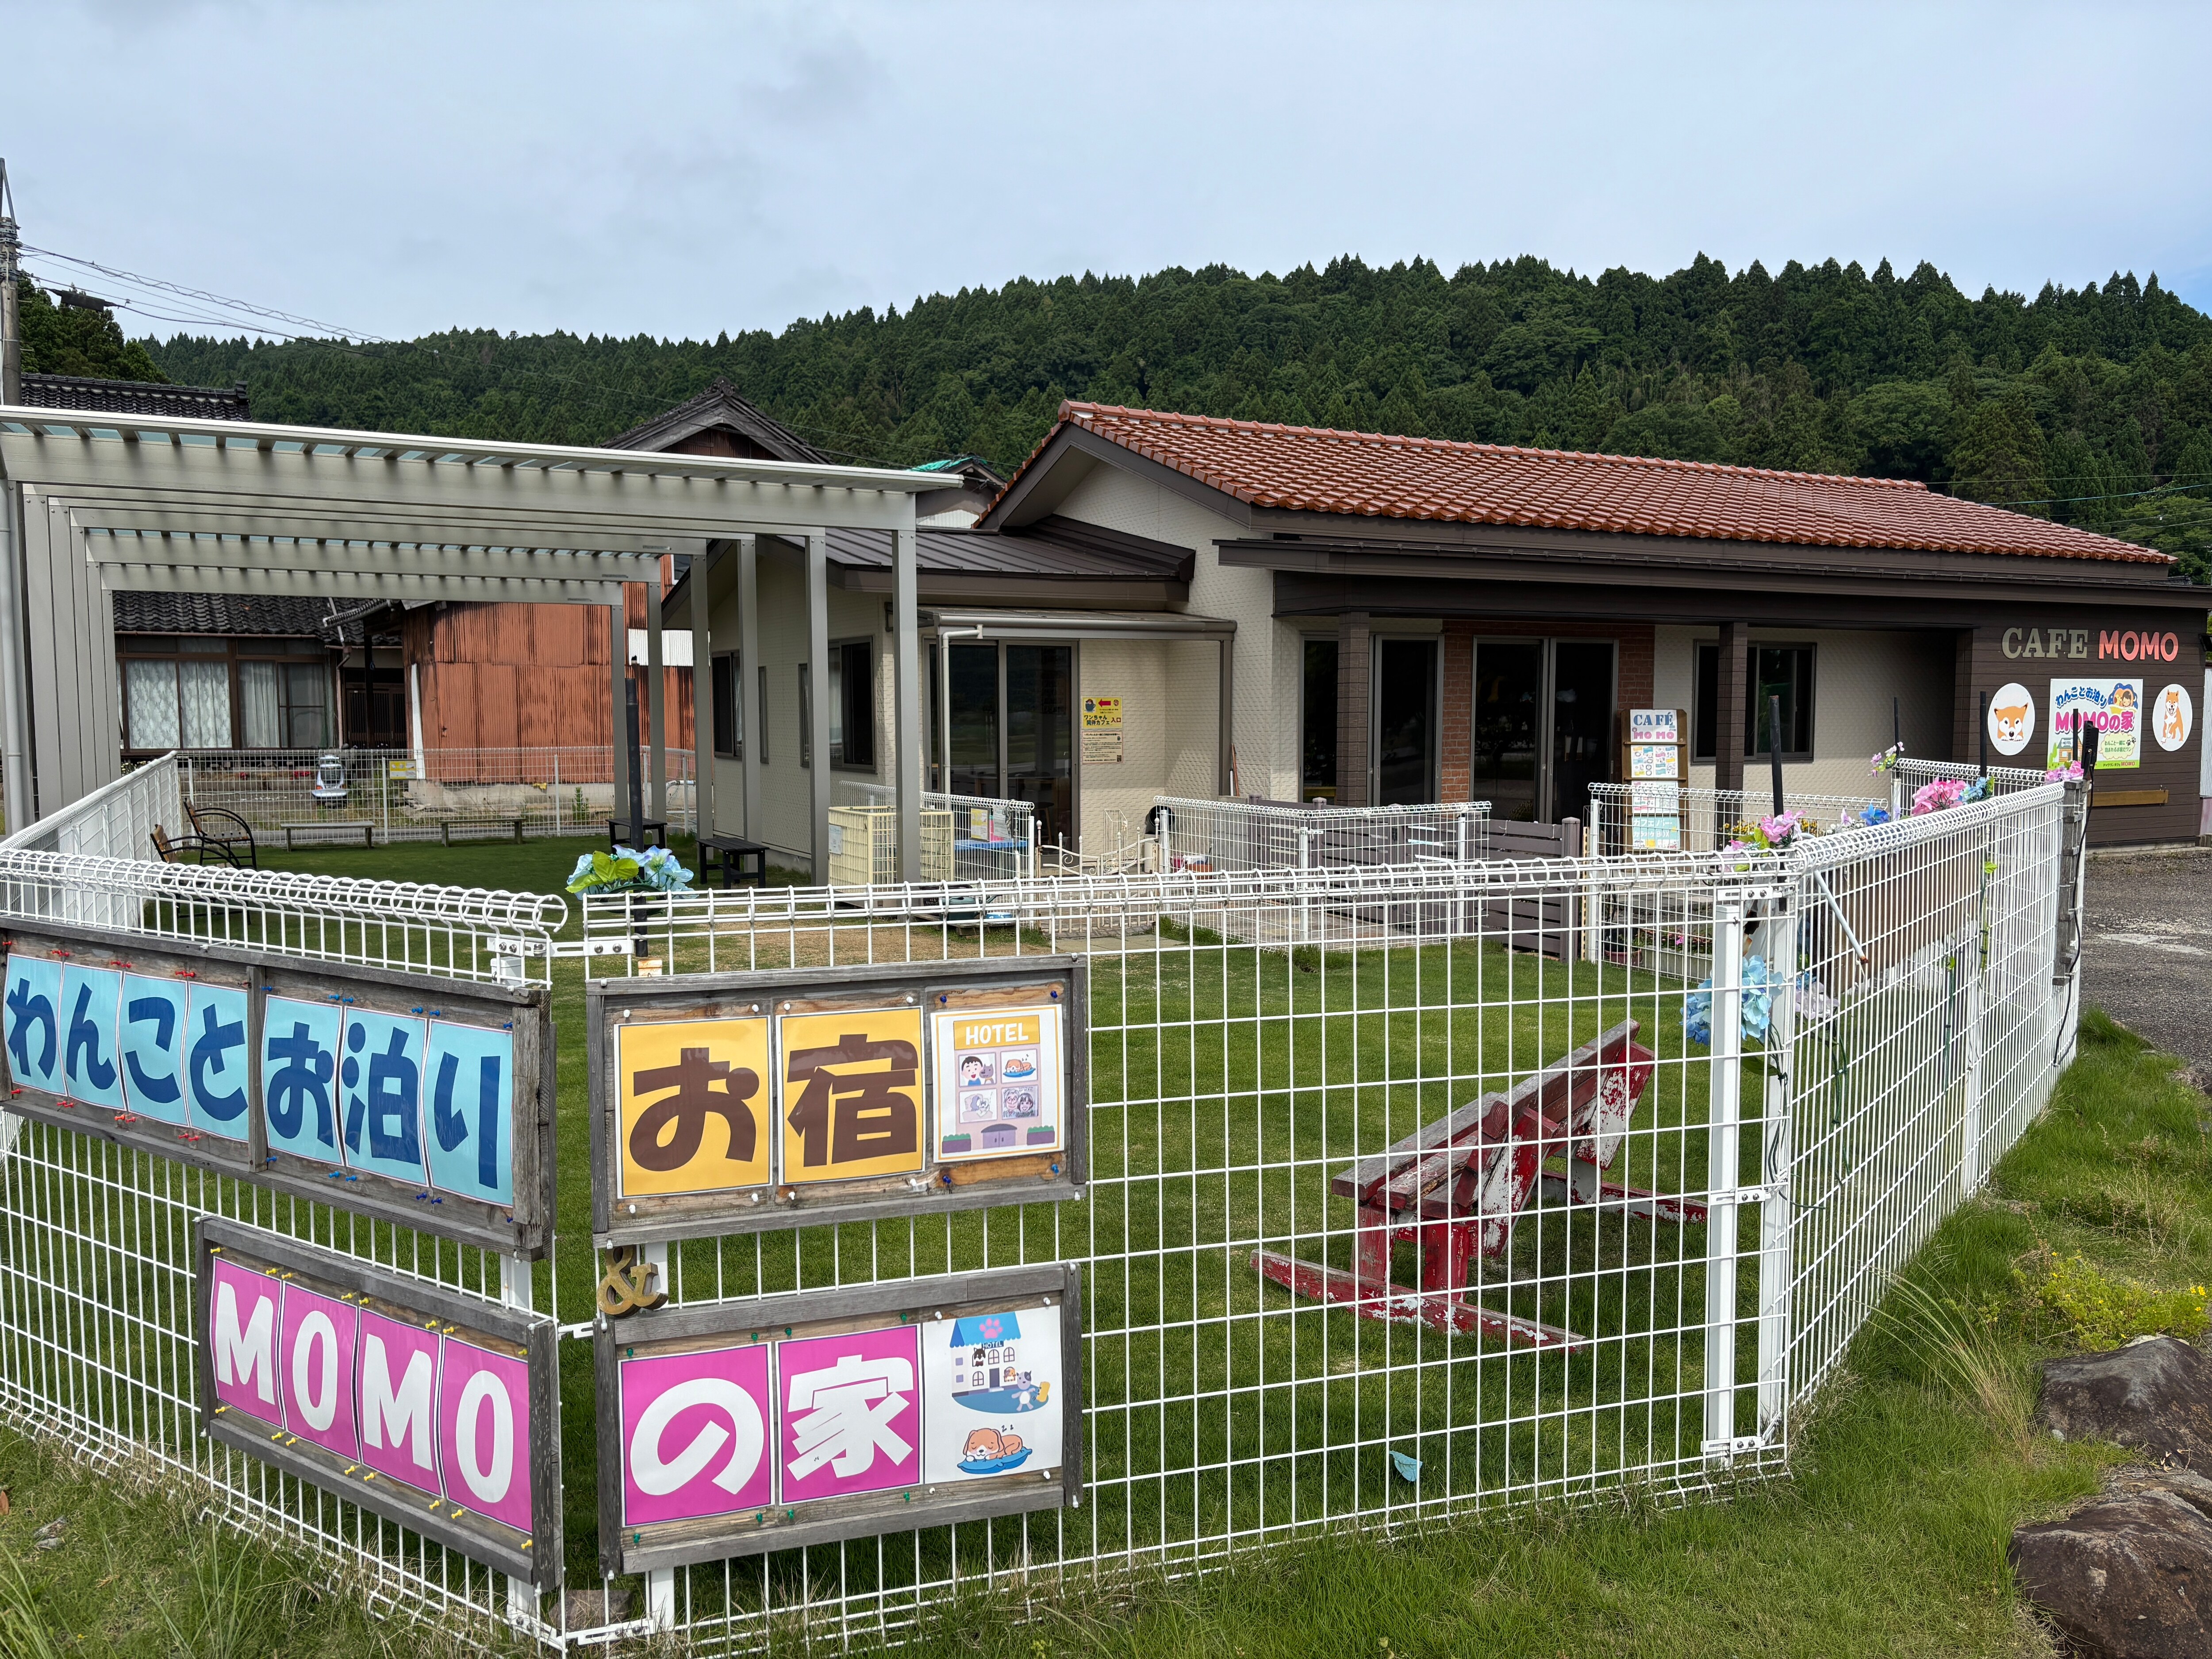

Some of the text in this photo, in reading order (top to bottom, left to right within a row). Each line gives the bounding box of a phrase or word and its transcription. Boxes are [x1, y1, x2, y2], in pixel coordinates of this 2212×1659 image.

[2002, 627, 2178, 662] CAFE MOMO
[2055, 686, 2107, 707] わんことお泊り
[965, 1022, 1029, 1046] HOTEL
[629, 1033, 918, 1171] お宿
[597, 1245, 667, 1317] &
[215, 1280, 515, 1503] MOMO
[630, 1354, 914, 1496] の家
